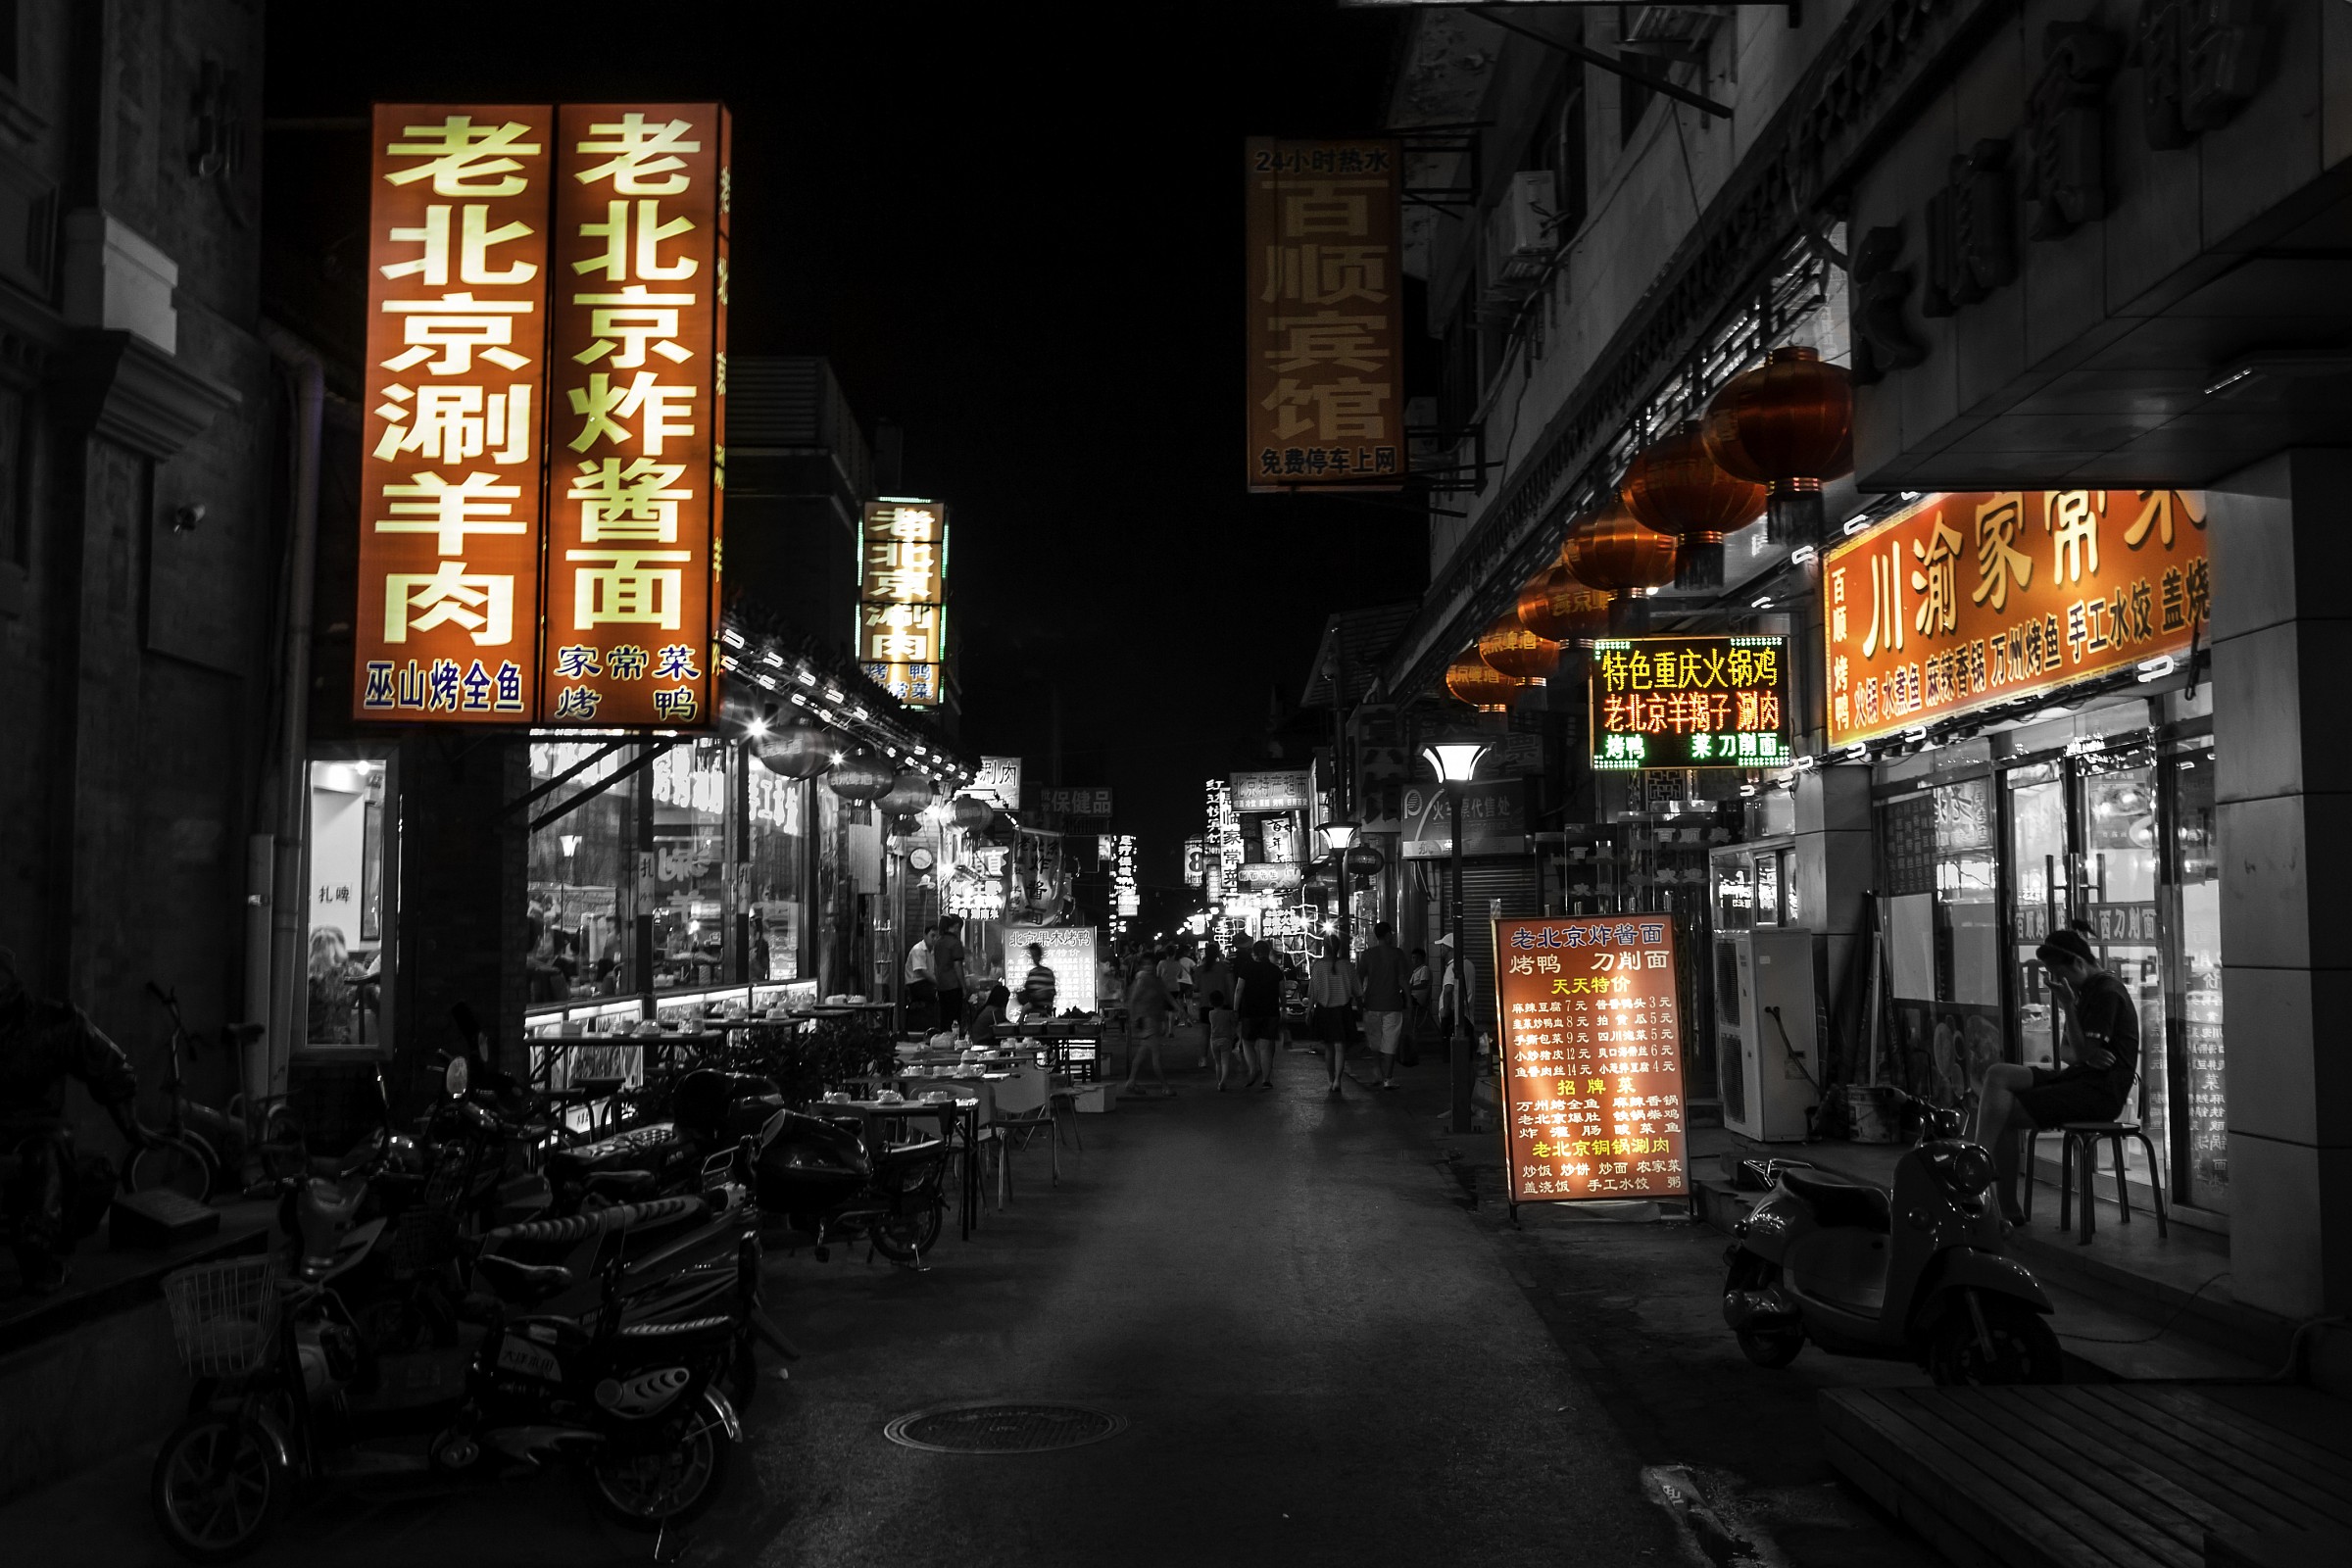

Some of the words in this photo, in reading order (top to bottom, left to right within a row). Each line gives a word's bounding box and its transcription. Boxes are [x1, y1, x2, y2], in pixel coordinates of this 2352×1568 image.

[1254, 149, 1391, 174] 24小时热水
[1260, 179, 1392, 442] 百顺宾馆
[372, 116, 541, 647] 老北京涮羊肉
[565, 114, 701, 631] 老北京炸酱面
[1260, 446, 1396, 474] 免费停车上网
[1990, 613, 2062, 687] 万州烤鱼
[2067, 575, 2154, 664] 手工水饺
[554, 645, 700, 681] 家常菜
[1602, 646, 1778, 692] 特色重庆火锅鸡
[364, 660, 525, 713] 巫山烤全鱼
[1718, 732, 1779, 757] 刀削面
[1233, 774, 1308, 800] 北京特产超市
[1052, 790, 1112, 814] 保健品
[1433, 792, 1511, 821] 火票代售处
[1009, 929, 1092, 948] 北京果木烤鸭
[1511, 923, 1665, 950] 老北京炸酱面
[1509, 955, 1561, 975] 烤鸭
[1590, 950, 1670, 971] 刀削面
[1551, 975, 1631, 995] 天天特价
[1557, 1076, 1637, 1097] 招牌菜
[1516, 1099, 1600, 1112] 万州烤全鱼
[1612, 1095, 1679, 1108] 麻辣香锅
[1517, 1112, 1601, 1126] 老北京爆肚
[1532, 1138, 1670, 1158] 老北京铜锅涮肉
[1522, 1164, 1553, 1178] 炒饭
[1560, 1162, 1591, 1177] 炒饼
[1598, 1160, 1629, 1175] 炒面
[1636, 1158, 1682, 1173] 农家菜
[1523, 1179, 1571, 1195] 盖浇饭
[1587, 1176, 1650, 1192] 手工水饺
